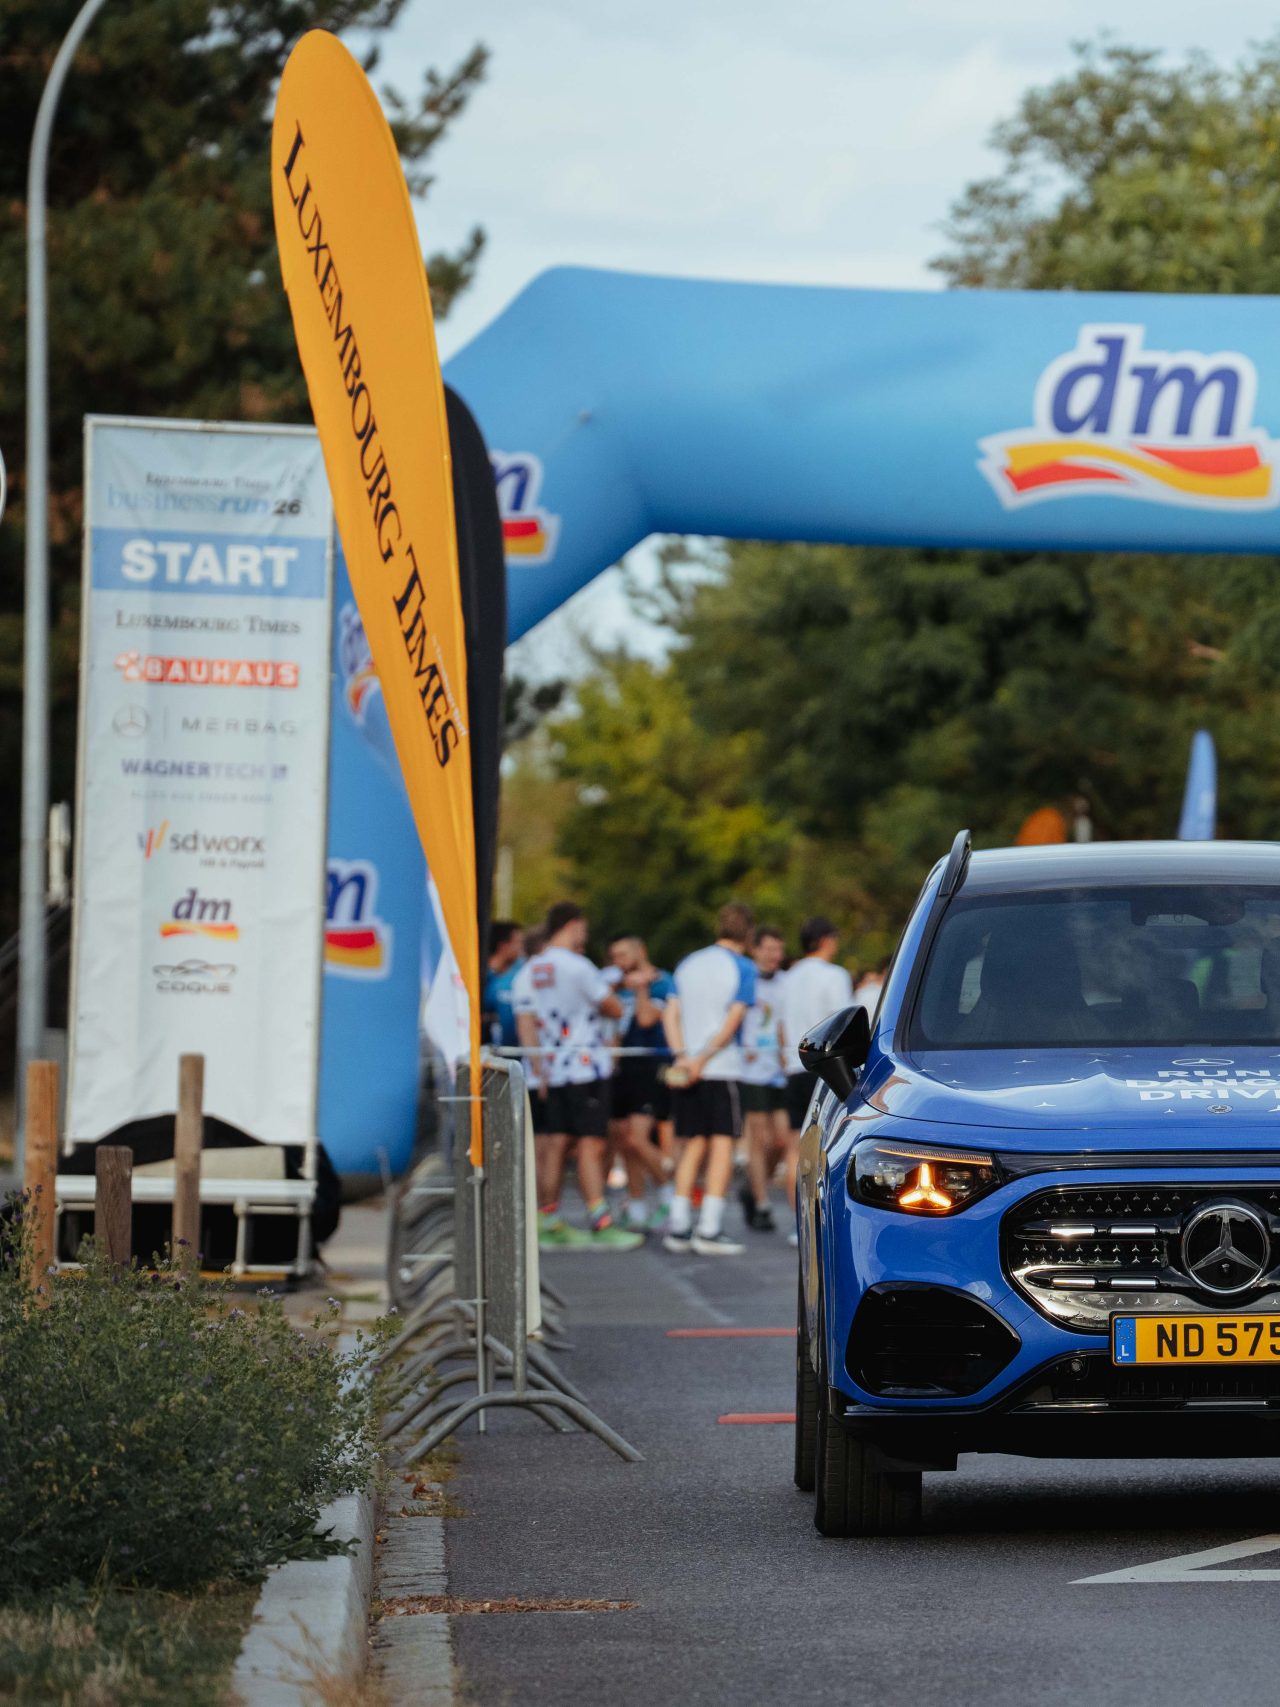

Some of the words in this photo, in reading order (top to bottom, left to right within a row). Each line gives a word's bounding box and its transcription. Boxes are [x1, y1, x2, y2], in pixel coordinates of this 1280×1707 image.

[1050, 336, 1240, 437] dm
[283, 121, 401, 563] LUXEMBOURG
[393, 545, 459, 769] TIMES
[120, 539, 298, 588] START
[115, 609, 241, 632] LUXEMBOURG
[243, 614, 301, 635] TIMES
[144, 656, 299, 687] BAUHAUS
[181, 716, 297, 736] MERBAG
[121, 758, 265, 780] WAGNERTECH
[172, 888, 232, 922] dm
[1120, 1344, 1130, 1357] L
[1156, 1323, 1204, 1358] ND
